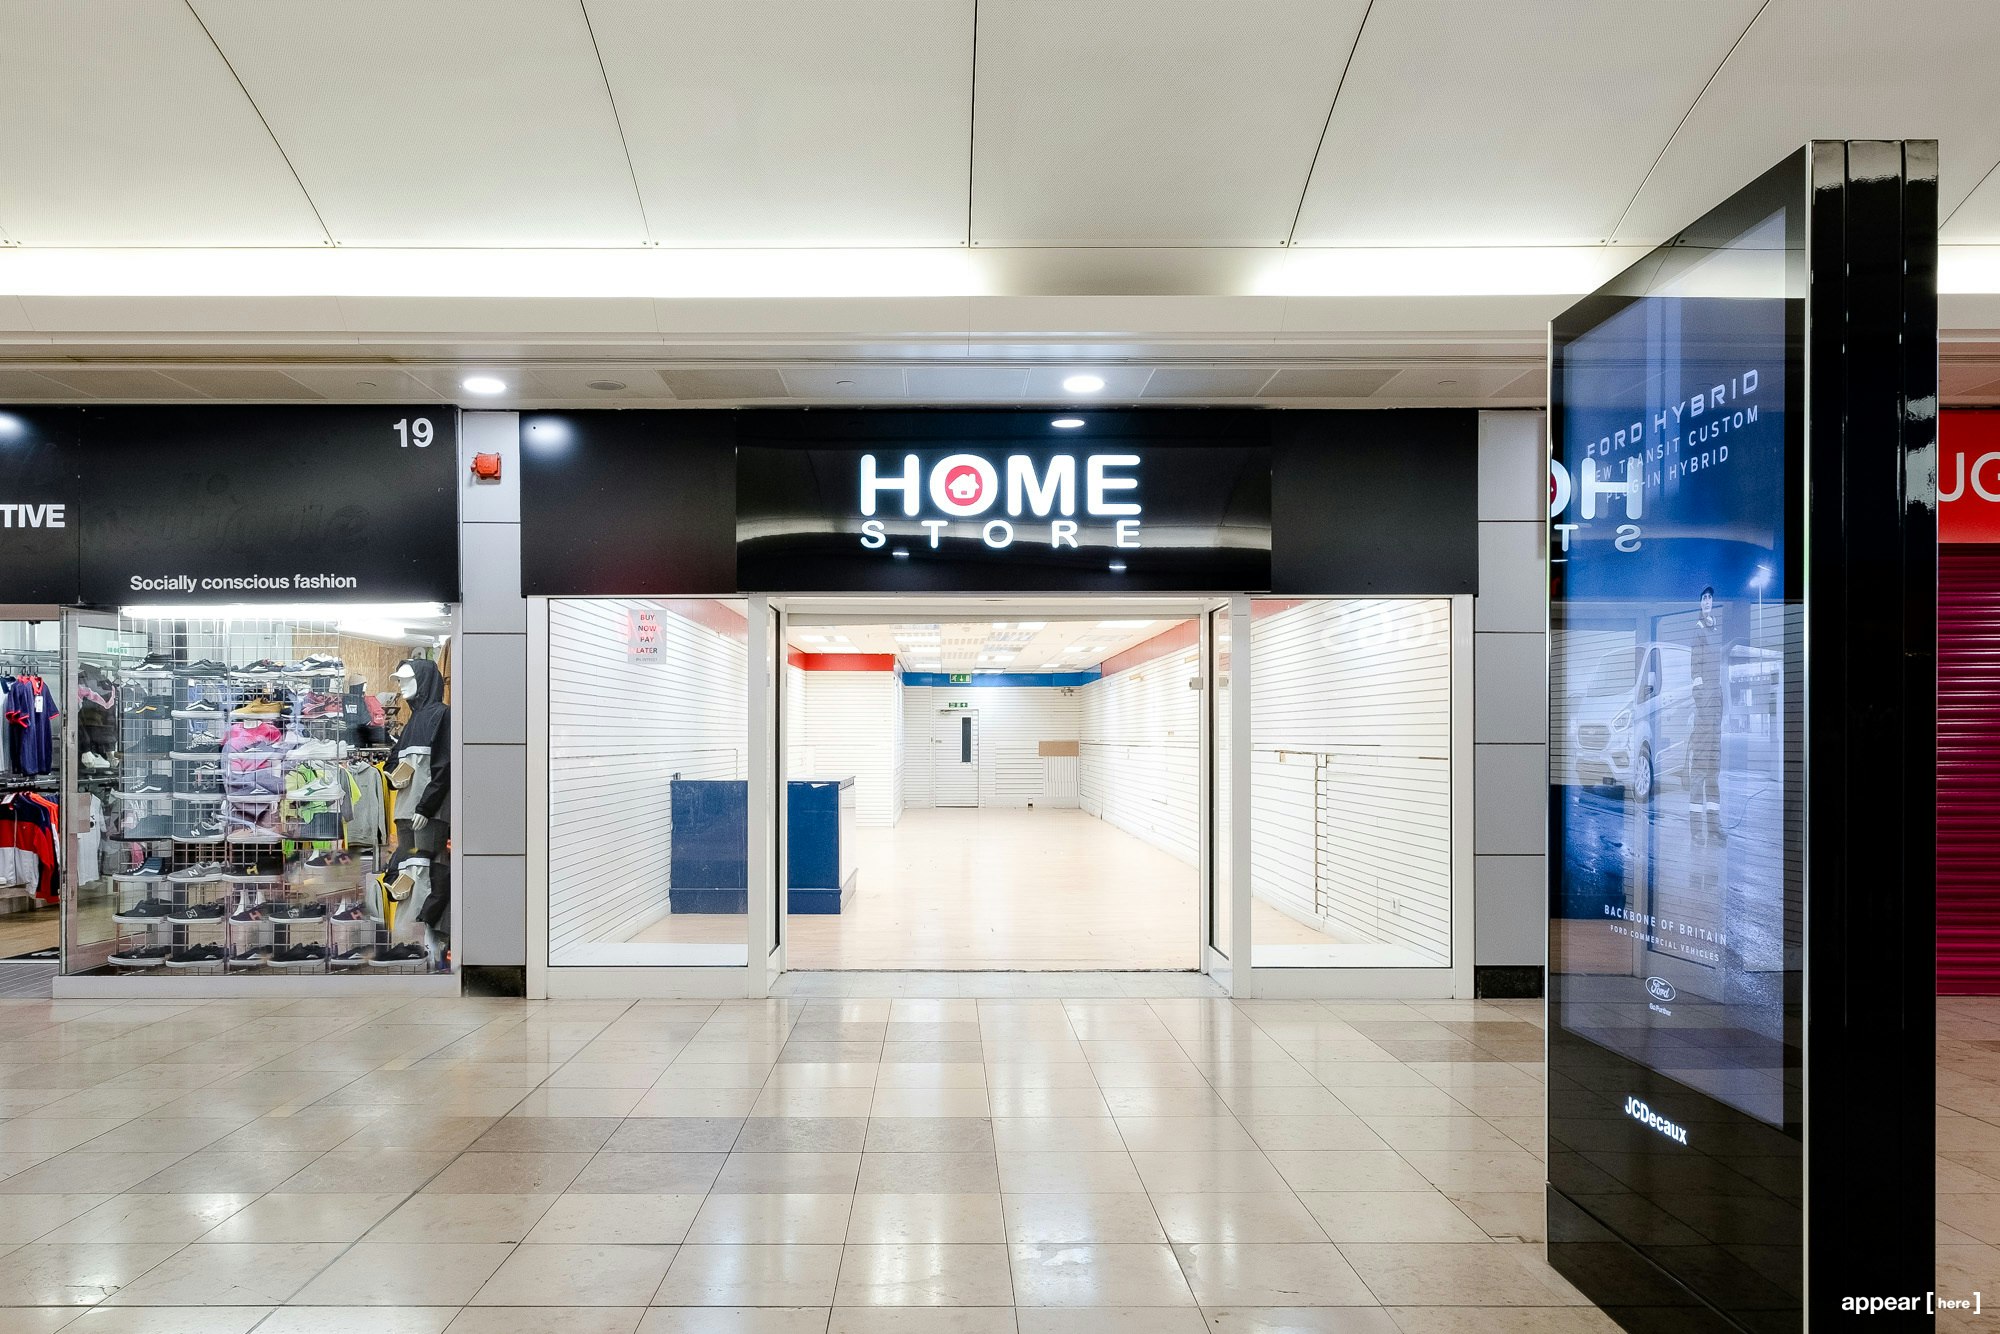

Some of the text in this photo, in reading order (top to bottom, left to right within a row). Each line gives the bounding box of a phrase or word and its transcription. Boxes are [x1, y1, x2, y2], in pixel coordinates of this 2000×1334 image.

[393, 417, 434, 448] 19
[1587, 369, 1759, 458] FORD HYBRID
[1619, 437, 1681, 474] TRANSIT
[1688, 405, 1759, 447] CUSTOM
[1669, 445, 1729, 481] HYBRID
[860, 453, 1142, 517] HOME
[0, 504, 65, 528] TIVE
[860, 520, 1142, 549] STORE
[130, 573, 358, 593] Socially conscious fashion
[1604, 904, 1727, 945] BACKBONE OF BRITAIN
[1610, 924, 1720, 962] FORD COMMERCIAL VEHICLES
[1625, 1096, 1688, 1146] JCDecaux
